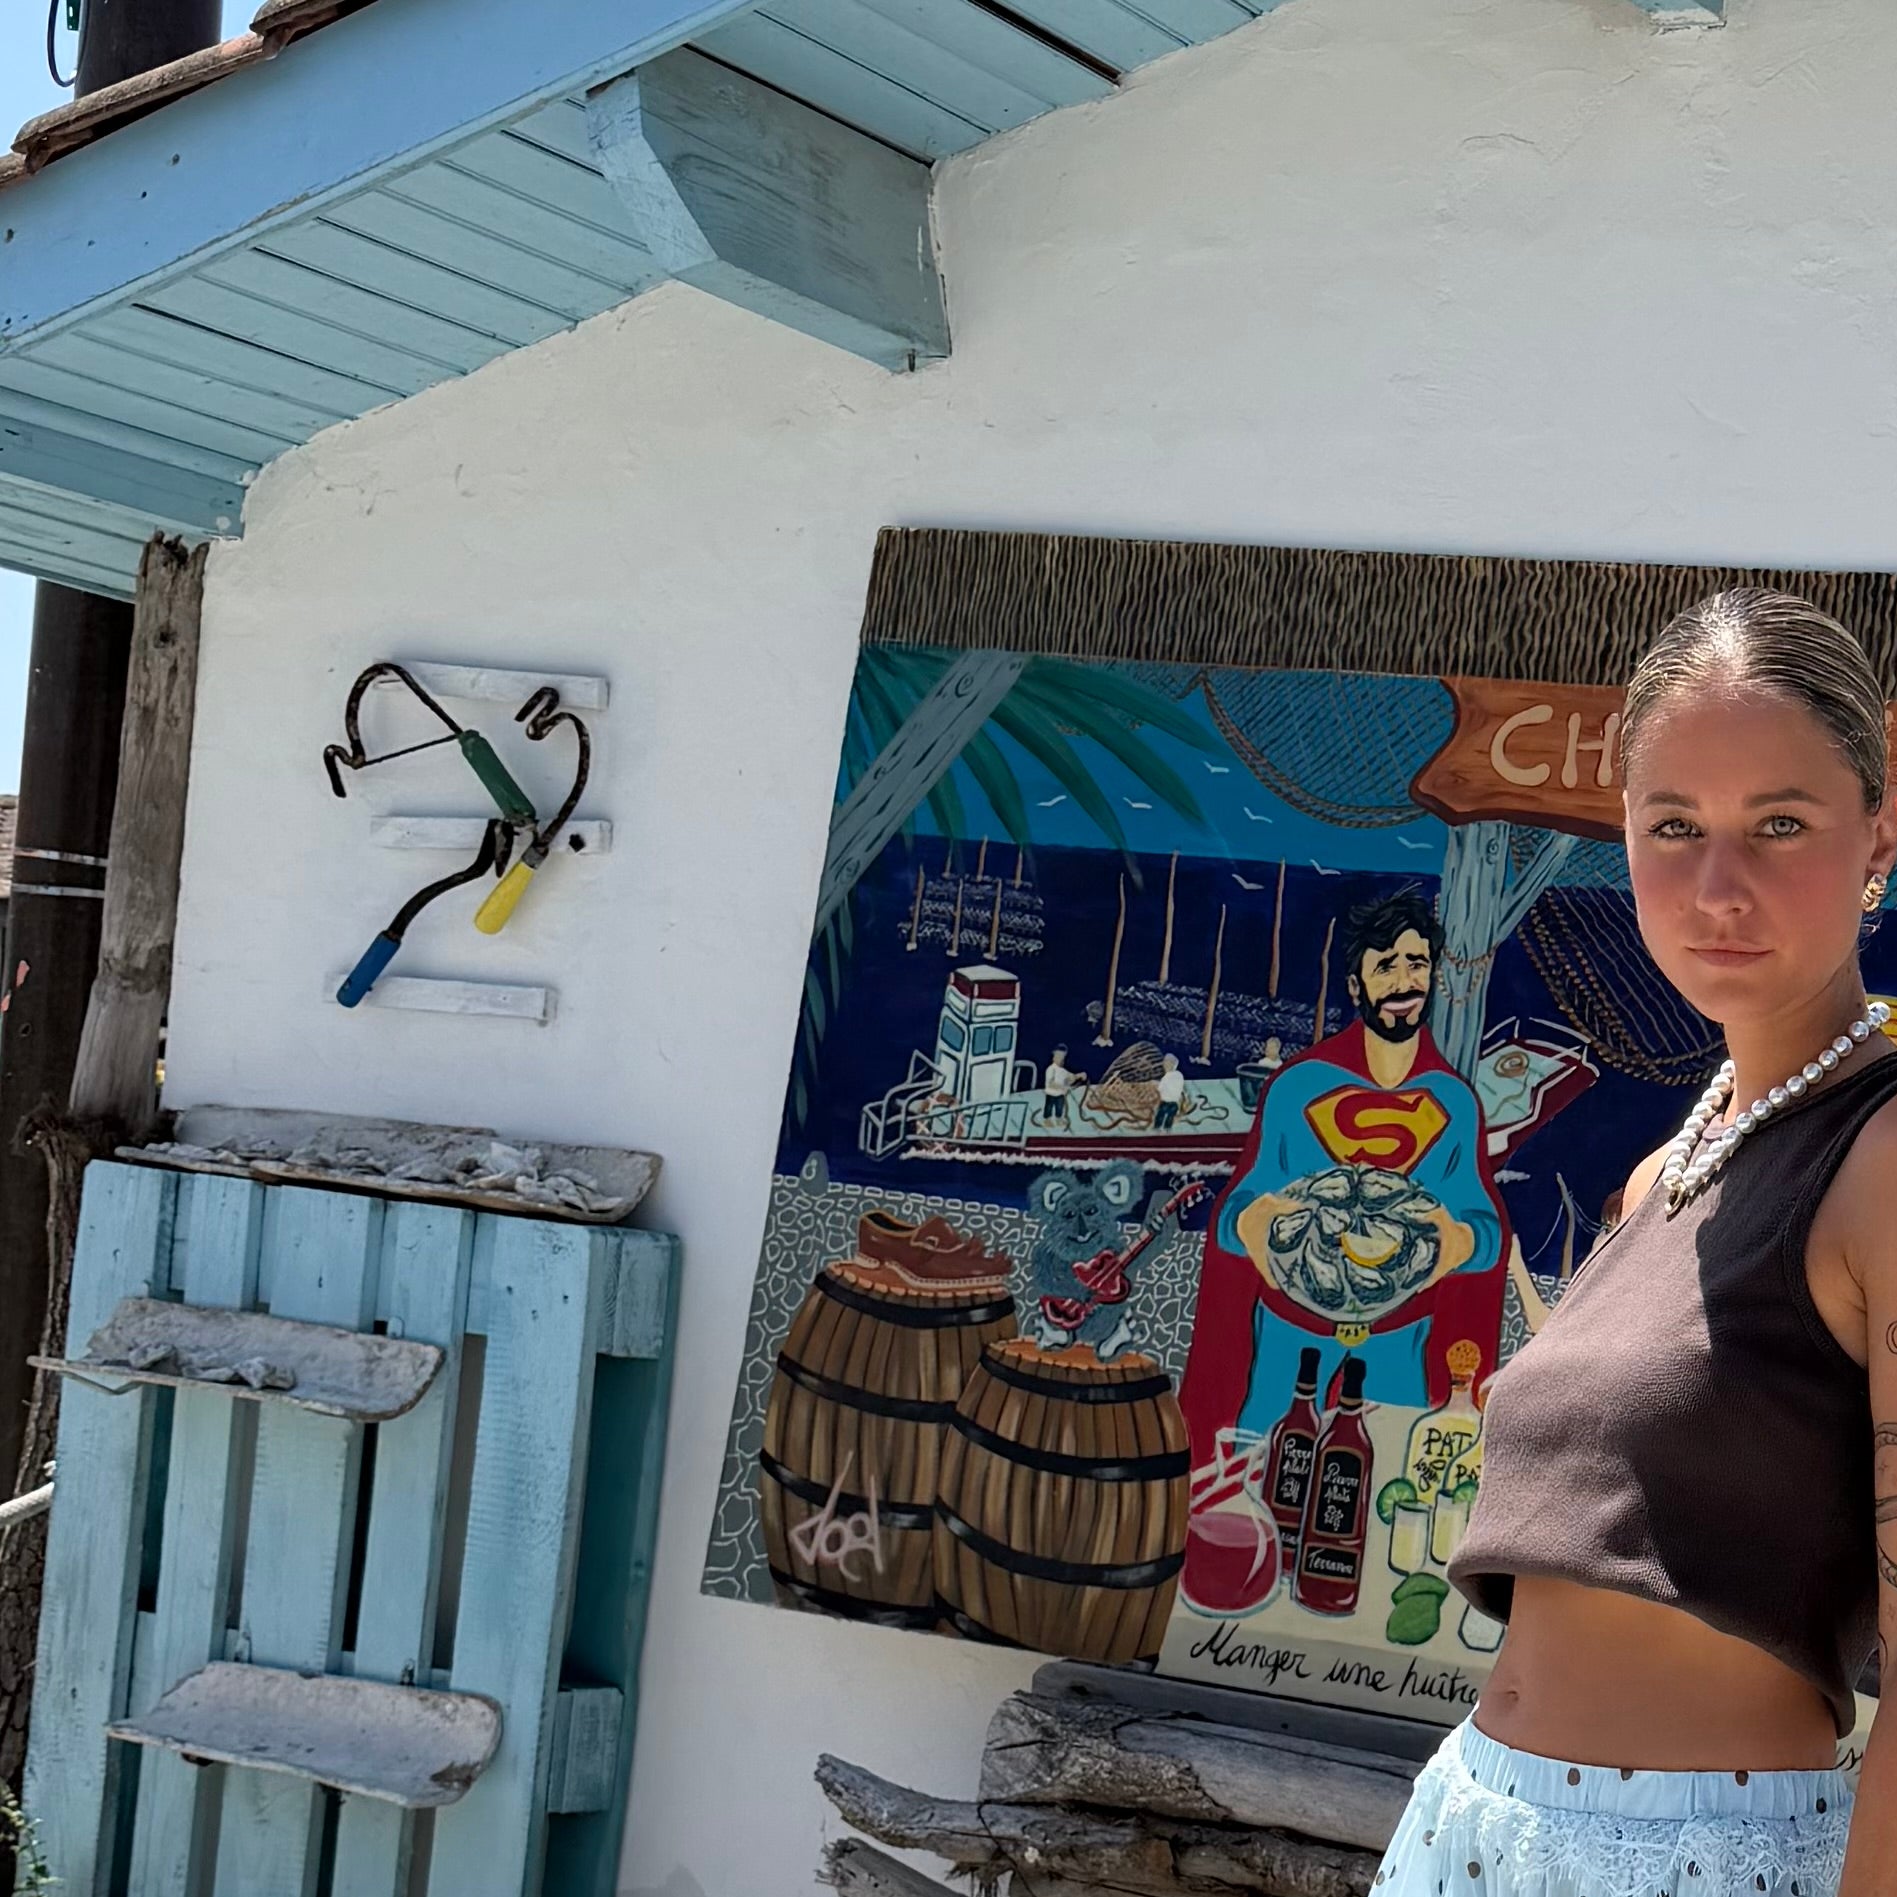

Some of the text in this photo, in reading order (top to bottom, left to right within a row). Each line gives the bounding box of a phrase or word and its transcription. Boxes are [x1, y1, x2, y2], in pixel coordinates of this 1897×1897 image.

[1490, 703, 1621, 789] CH
[1422, 1427, 1473, 1457] PAT
[1190, 1620, 1313, 1686] Manger
[1322, 1656, 1394, 1690] une
